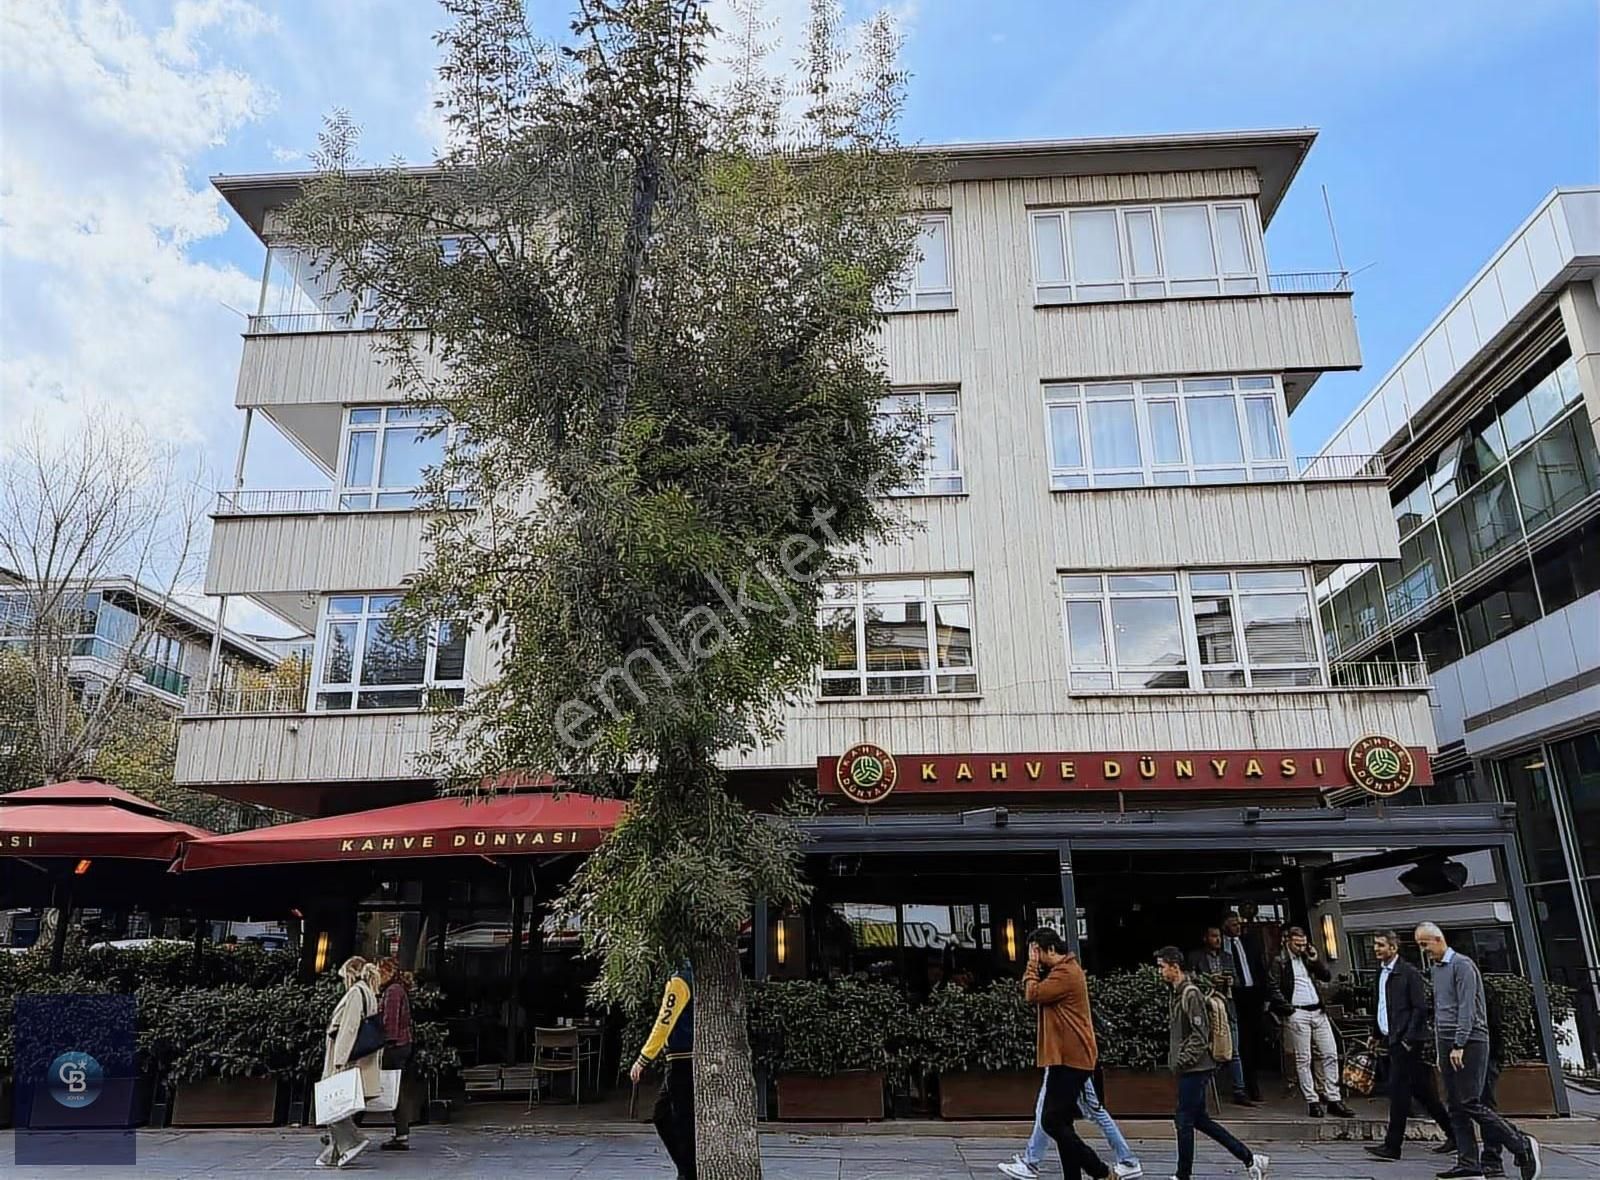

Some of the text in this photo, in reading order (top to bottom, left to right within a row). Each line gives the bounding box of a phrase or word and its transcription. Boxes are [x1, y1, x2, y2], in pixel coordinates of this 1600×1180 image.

[921, 755, 1326, 781] KAHVE DÜNYASI
[0, 836, 32, 848] SI
[341, 831, 577, 852] KAHVE DÜNYASI
